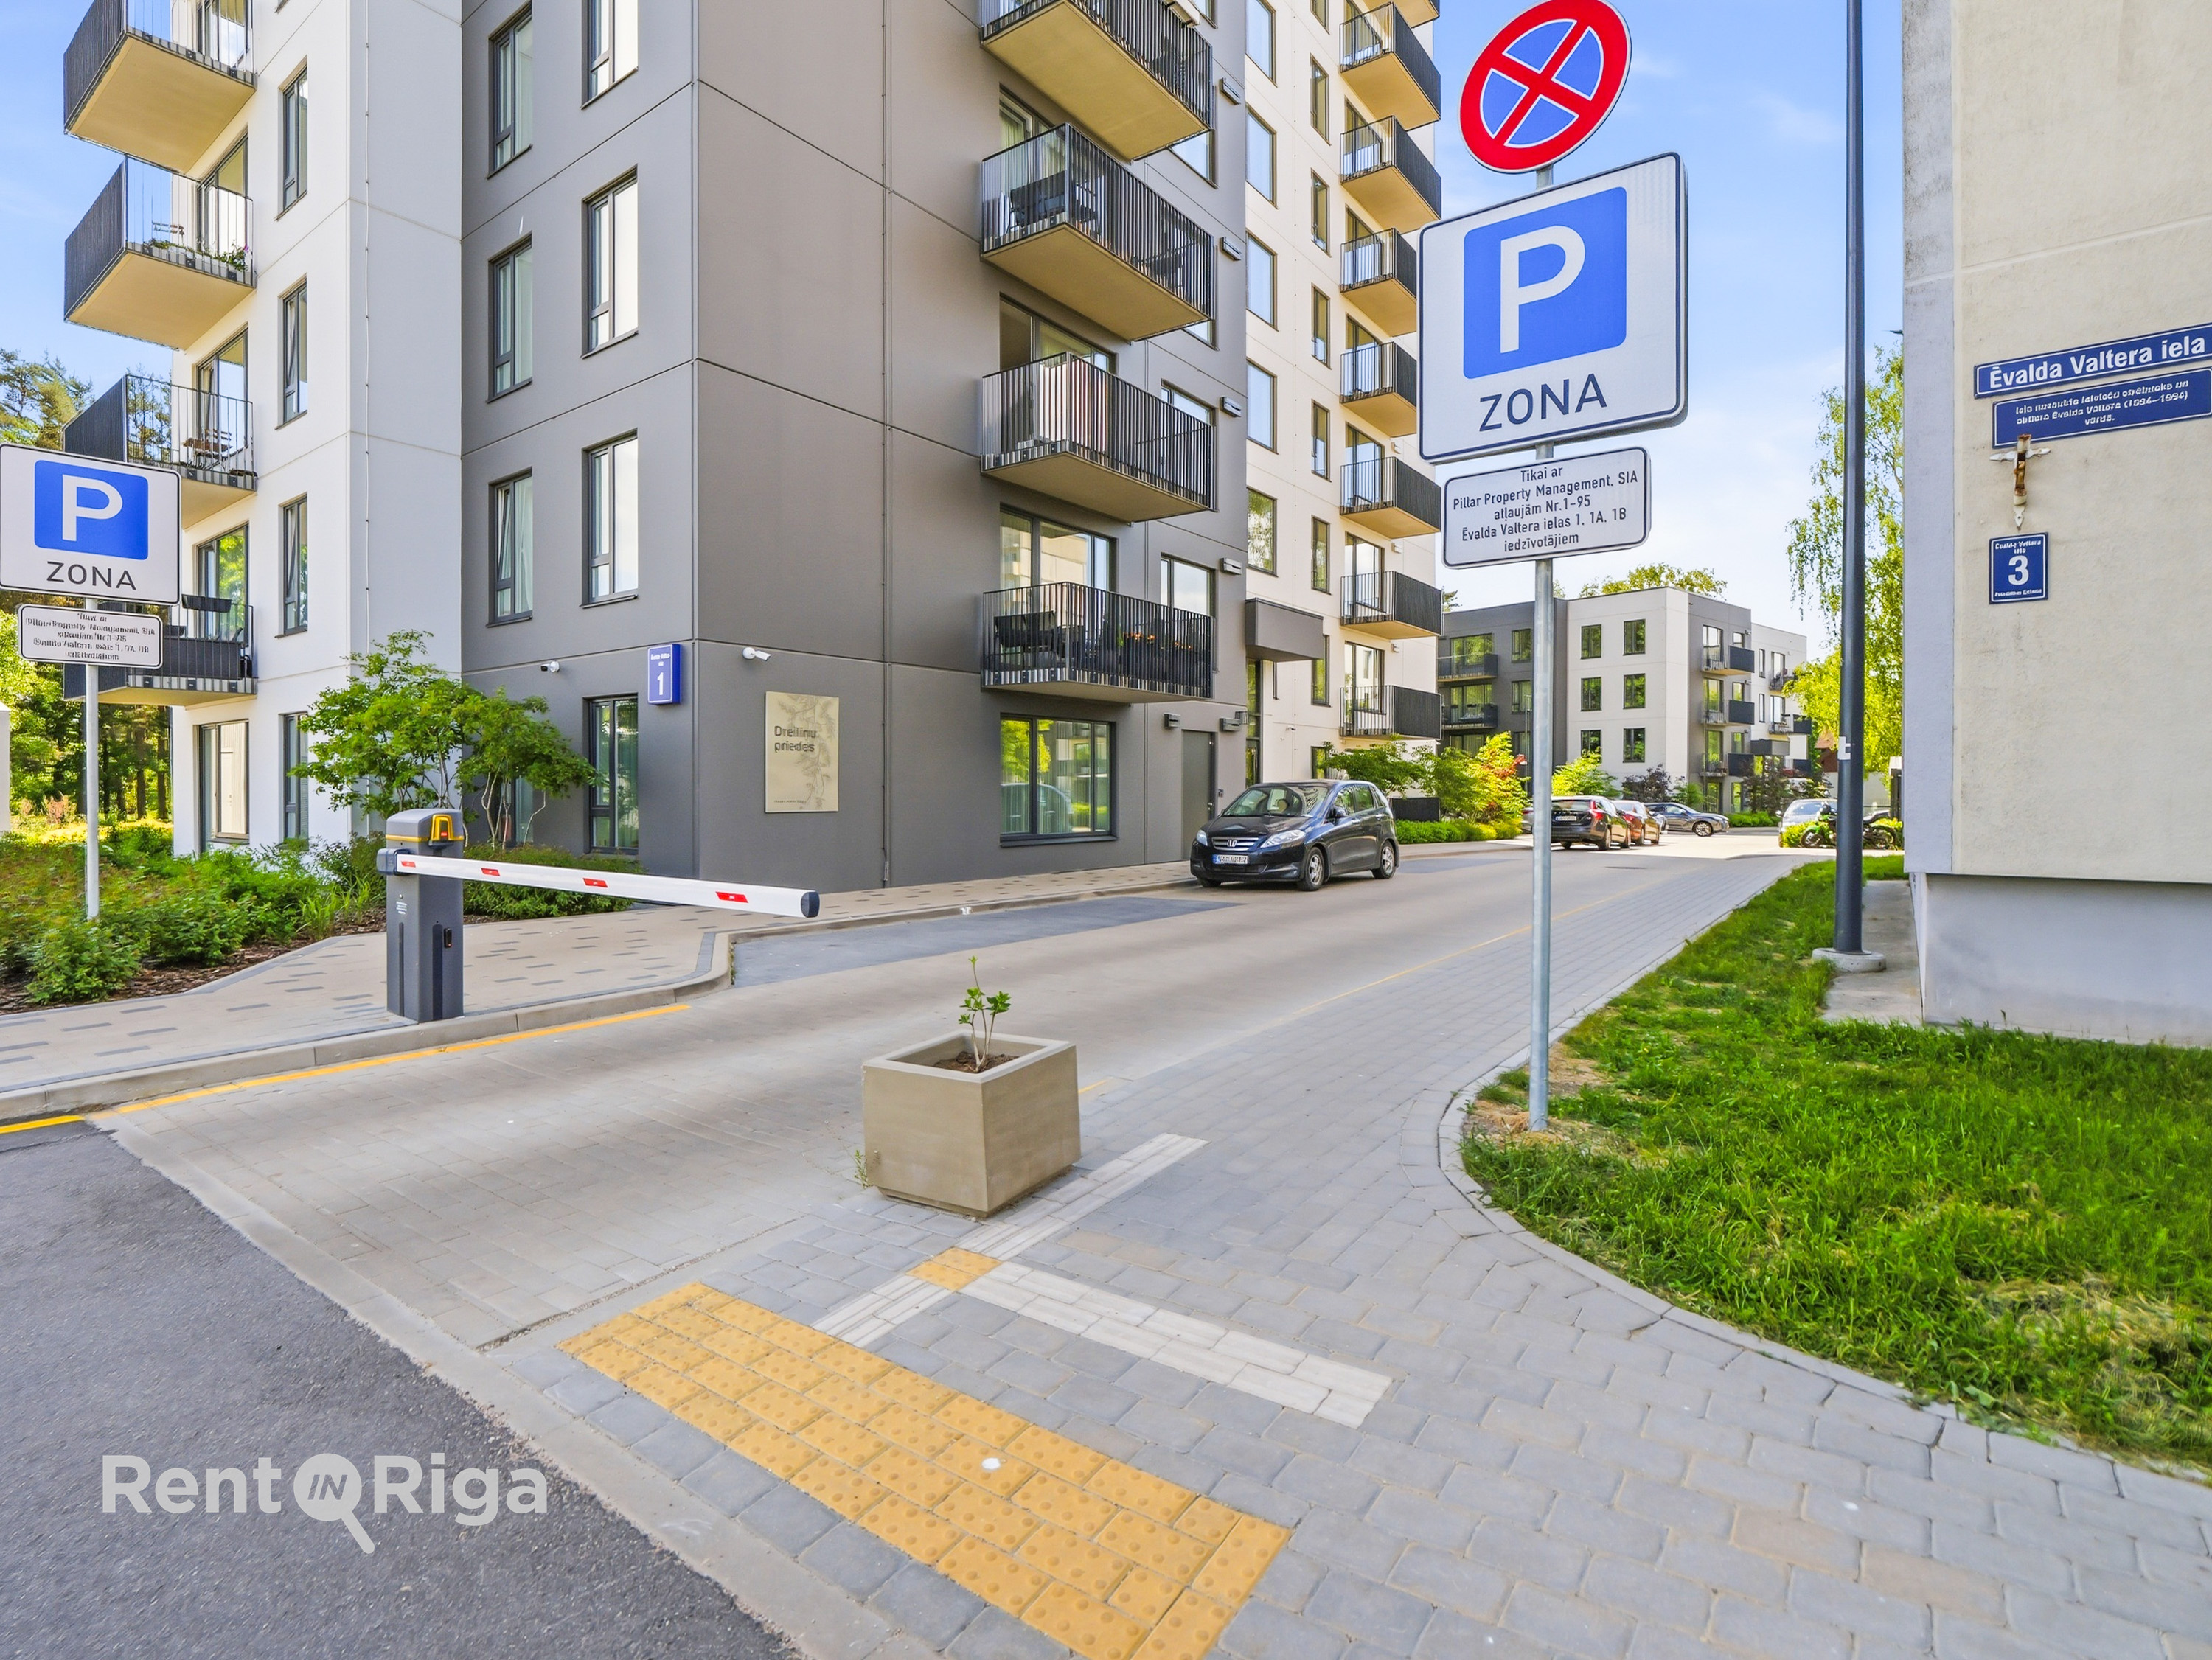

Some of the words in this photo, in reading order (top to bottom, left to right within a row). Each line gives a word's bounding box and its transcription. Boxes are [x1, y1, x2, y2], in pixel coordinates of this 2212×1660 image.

[1500, 225, 1586, 354] P
[2070, 346, 2152, 374] Valtera
[2161, 335, 2205, 360] iela
[1478, 373, 1608, 432] ZONA
[1453, 496, 1481, 510] Pillar
[1484, 488, 1531, 505] Property
[1618, 470, 1638, 485] SIA
[1520, 466, 1548, 482] Tikai
[1551, 467, 1563, 478] ar
[62, 474, 123, 541] P
[1462, 526, 1497, 541] Ēvalda
[1500, 521, 1540, 535] Valtera
[1544, 516, 1571, 530] ielas
[1612, 507, 1627, 520] 1B
[46, 561, 136, 590] ZONA
[2008, 555, 2029, 586] 3
[657, 672, 664, 696] 1
